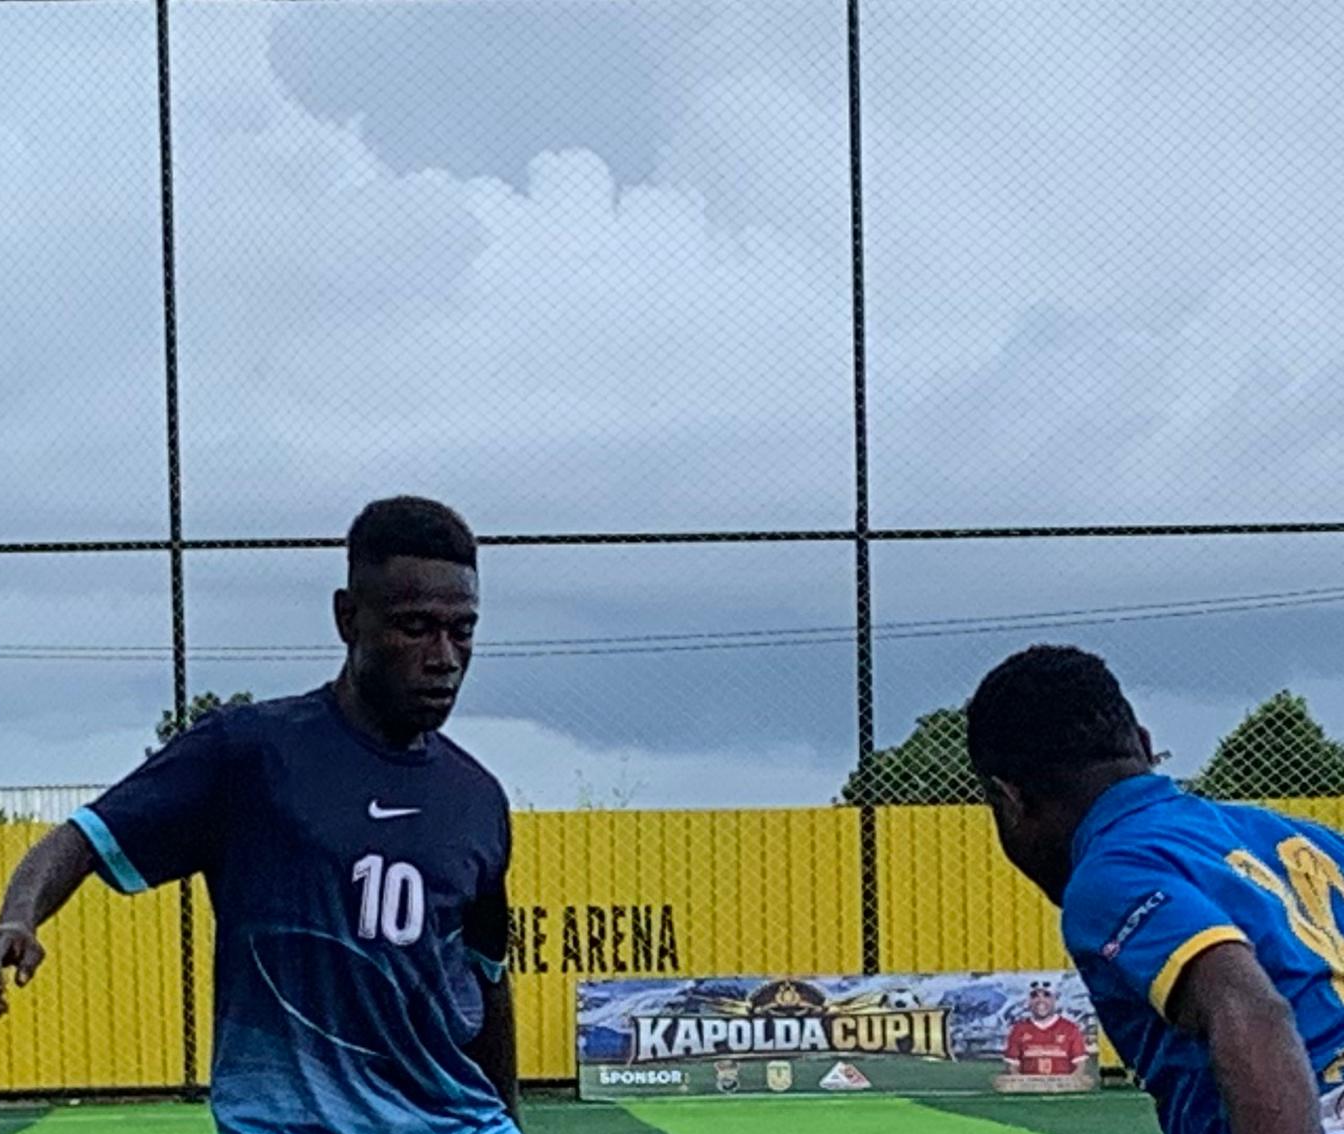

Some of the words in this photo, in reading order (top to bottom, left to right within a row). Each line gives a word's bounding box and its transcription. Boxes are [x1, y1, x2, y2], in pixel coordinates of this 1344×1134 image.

[352, 854, 425, 946] 10
[562, 905, 680, 973] ARENA
[637, 1017, 830, 1060] KAPOLDA
